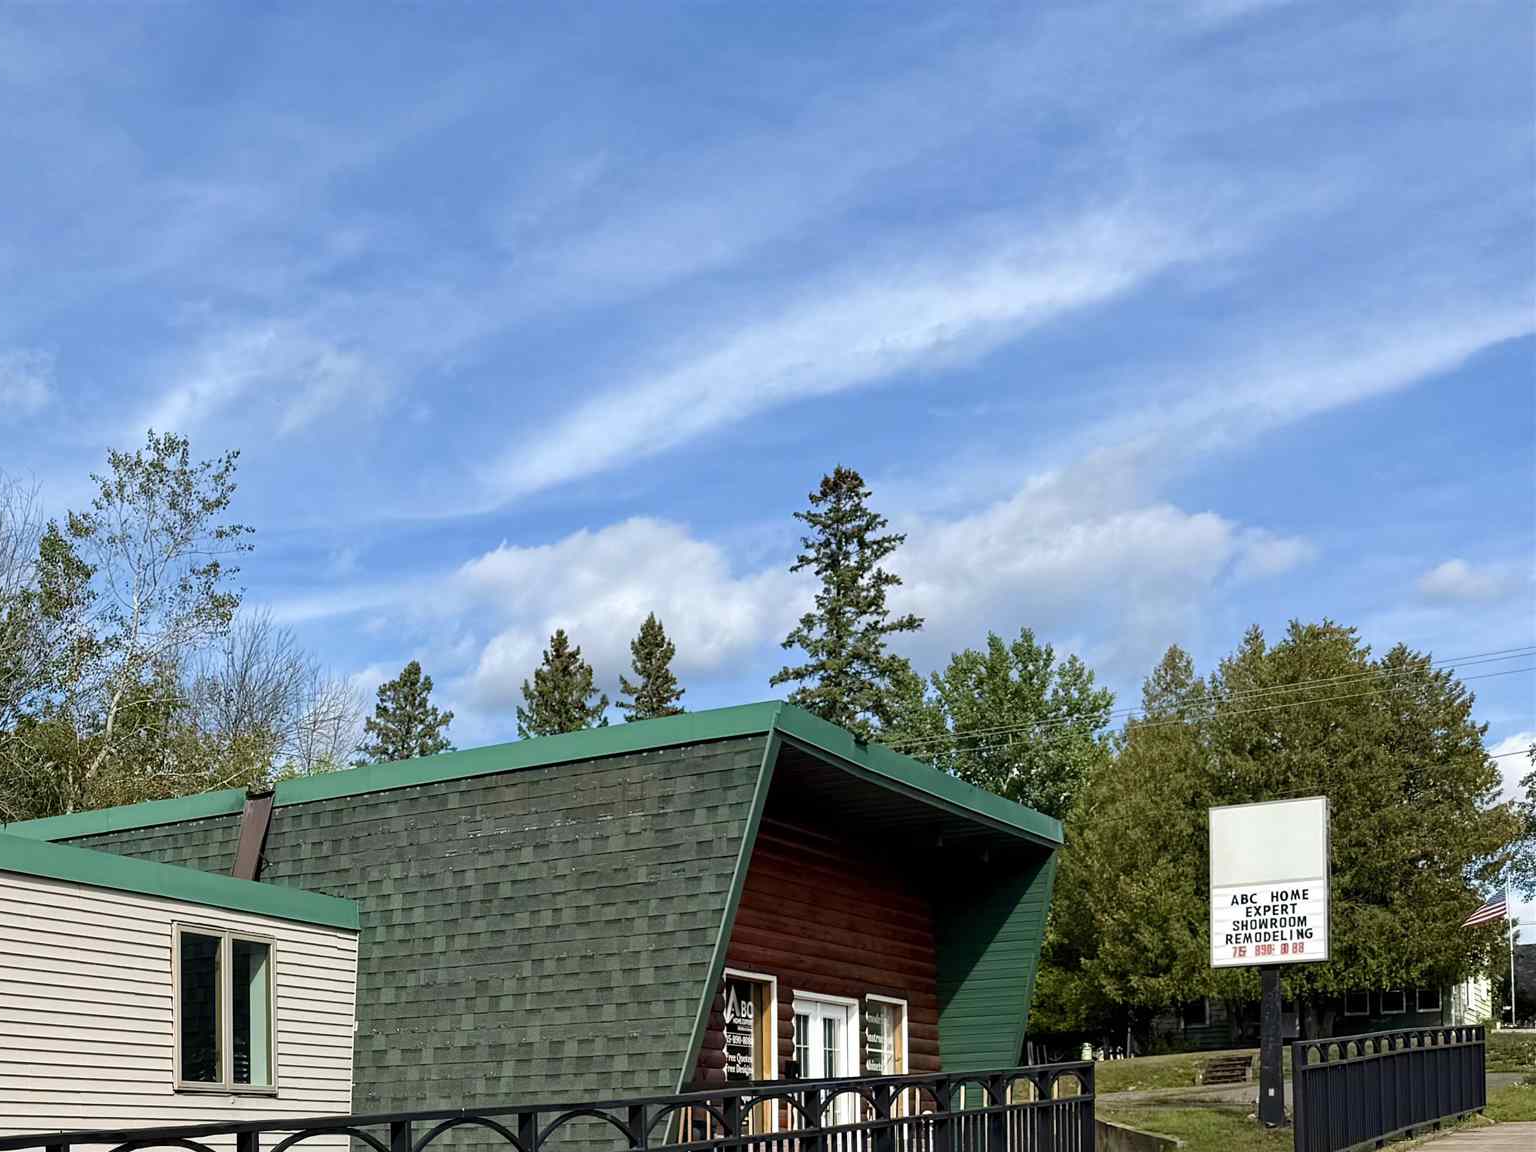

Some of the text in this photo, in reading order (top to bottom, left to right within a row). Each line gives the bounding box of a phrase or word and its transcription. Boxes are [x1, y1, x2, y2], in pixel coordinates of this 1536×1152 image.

[1231, 888, 1309, 906] ABC HOME
[1245, 902, 1298, 918] EXPERT
[1232, 915, 1307, 932] SHOWROOM
[1225, 927, 1314, 945] REMODELING
